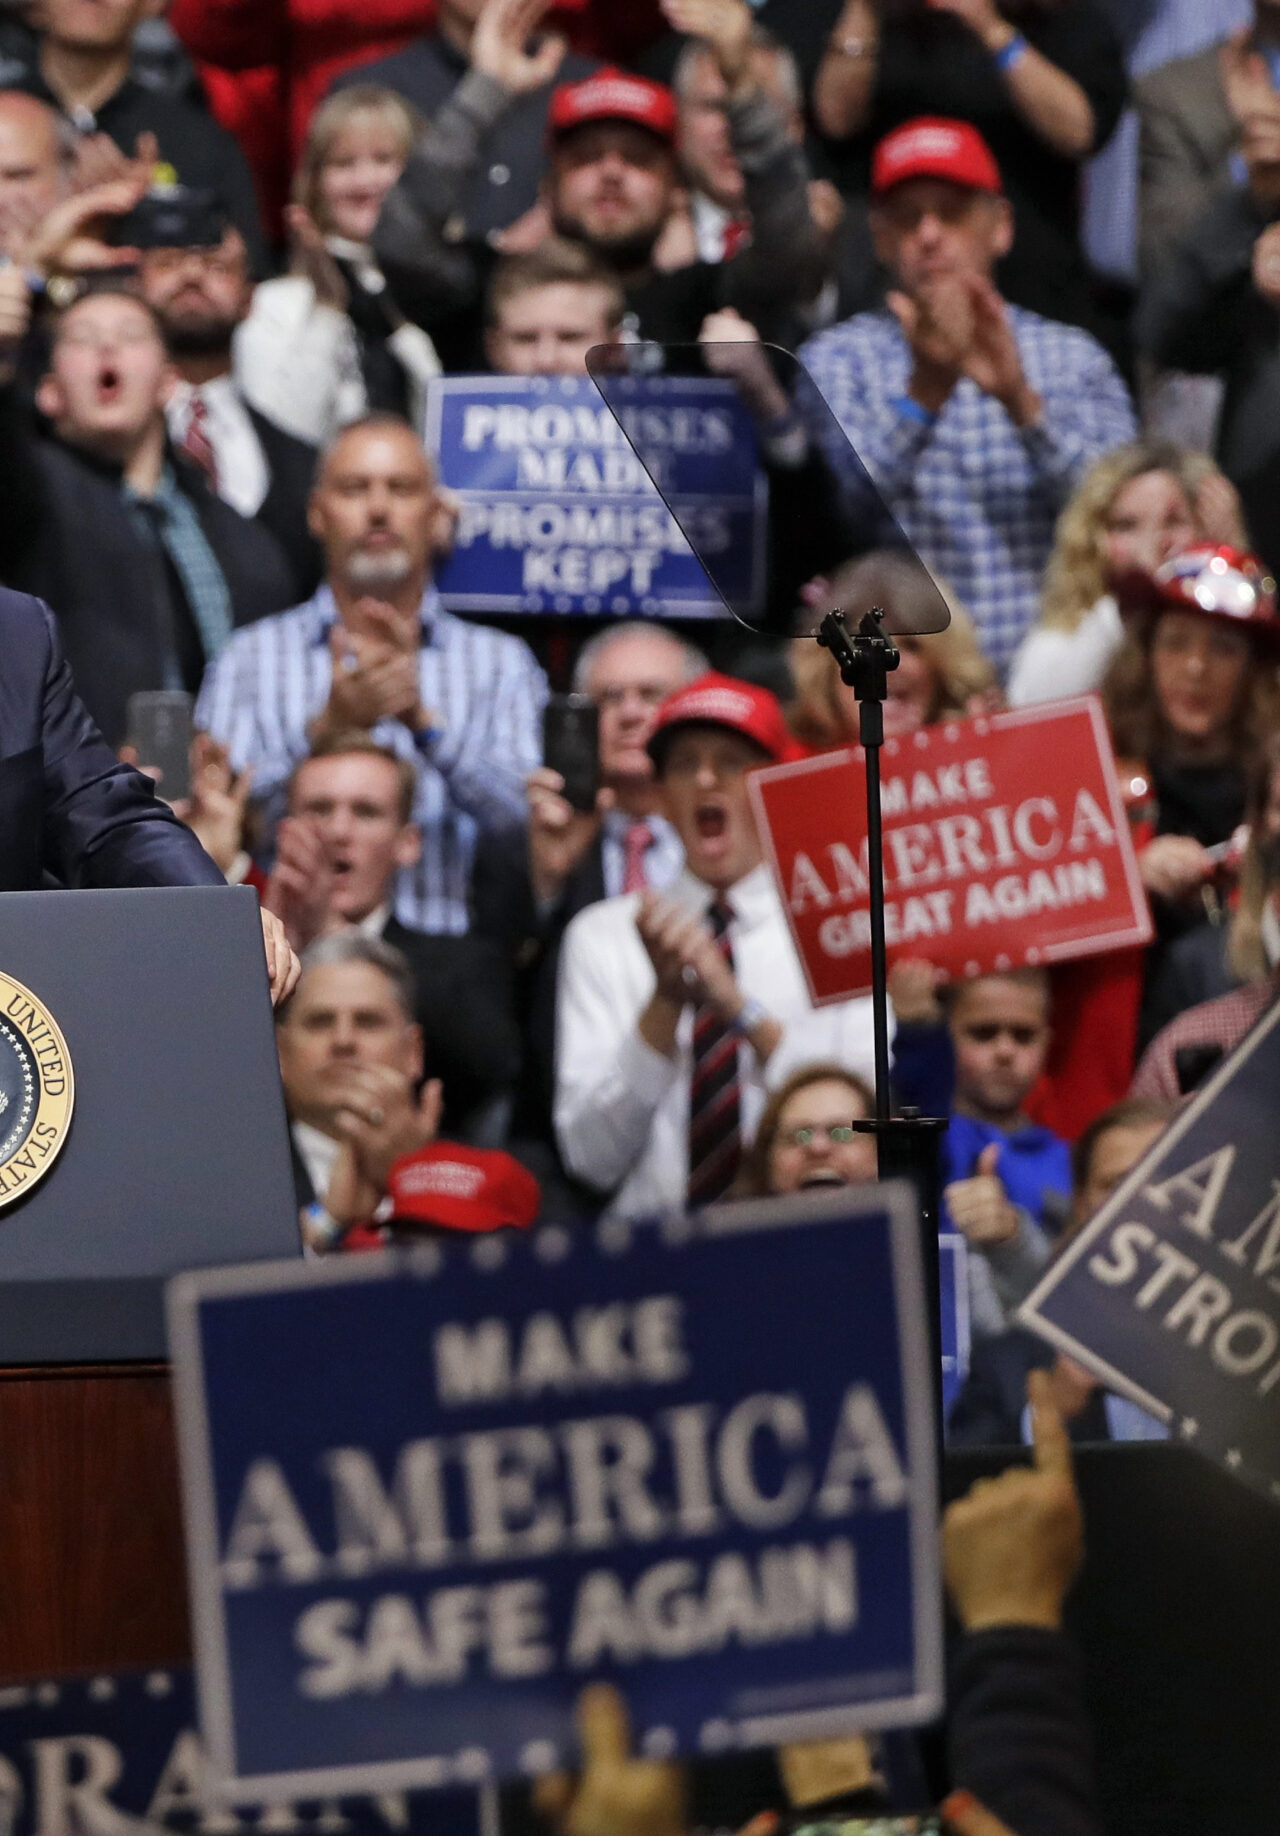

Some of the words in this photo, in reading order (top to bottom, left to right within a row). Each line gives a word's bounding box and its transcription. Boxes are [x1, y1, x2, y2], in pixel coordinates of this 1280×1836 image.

[462, 403, 733, 452] PROMISES
[516, 447, 676, 493] MADE
[457, 500, 732, 555] PROMISES
[522, 549, 662, 596] KEPT
[879, 757, 995, 817] MAKE
[789, 787, 1117, 917] AMERICA
[819, 888, 954, 959] GREAT
[965, 857, 1108, 928] AGAIN
[6, 993, 66, 1097] UNITED
[431, 1296, 690, 1403] MAKE
[1089, 1221, 1280, 1397] STRO
[219, 1382, 912, 1590] AMERICA
[294, 1578, 554, 1700] SAFE
[568, 1537, 858, 1669] AGAIN
